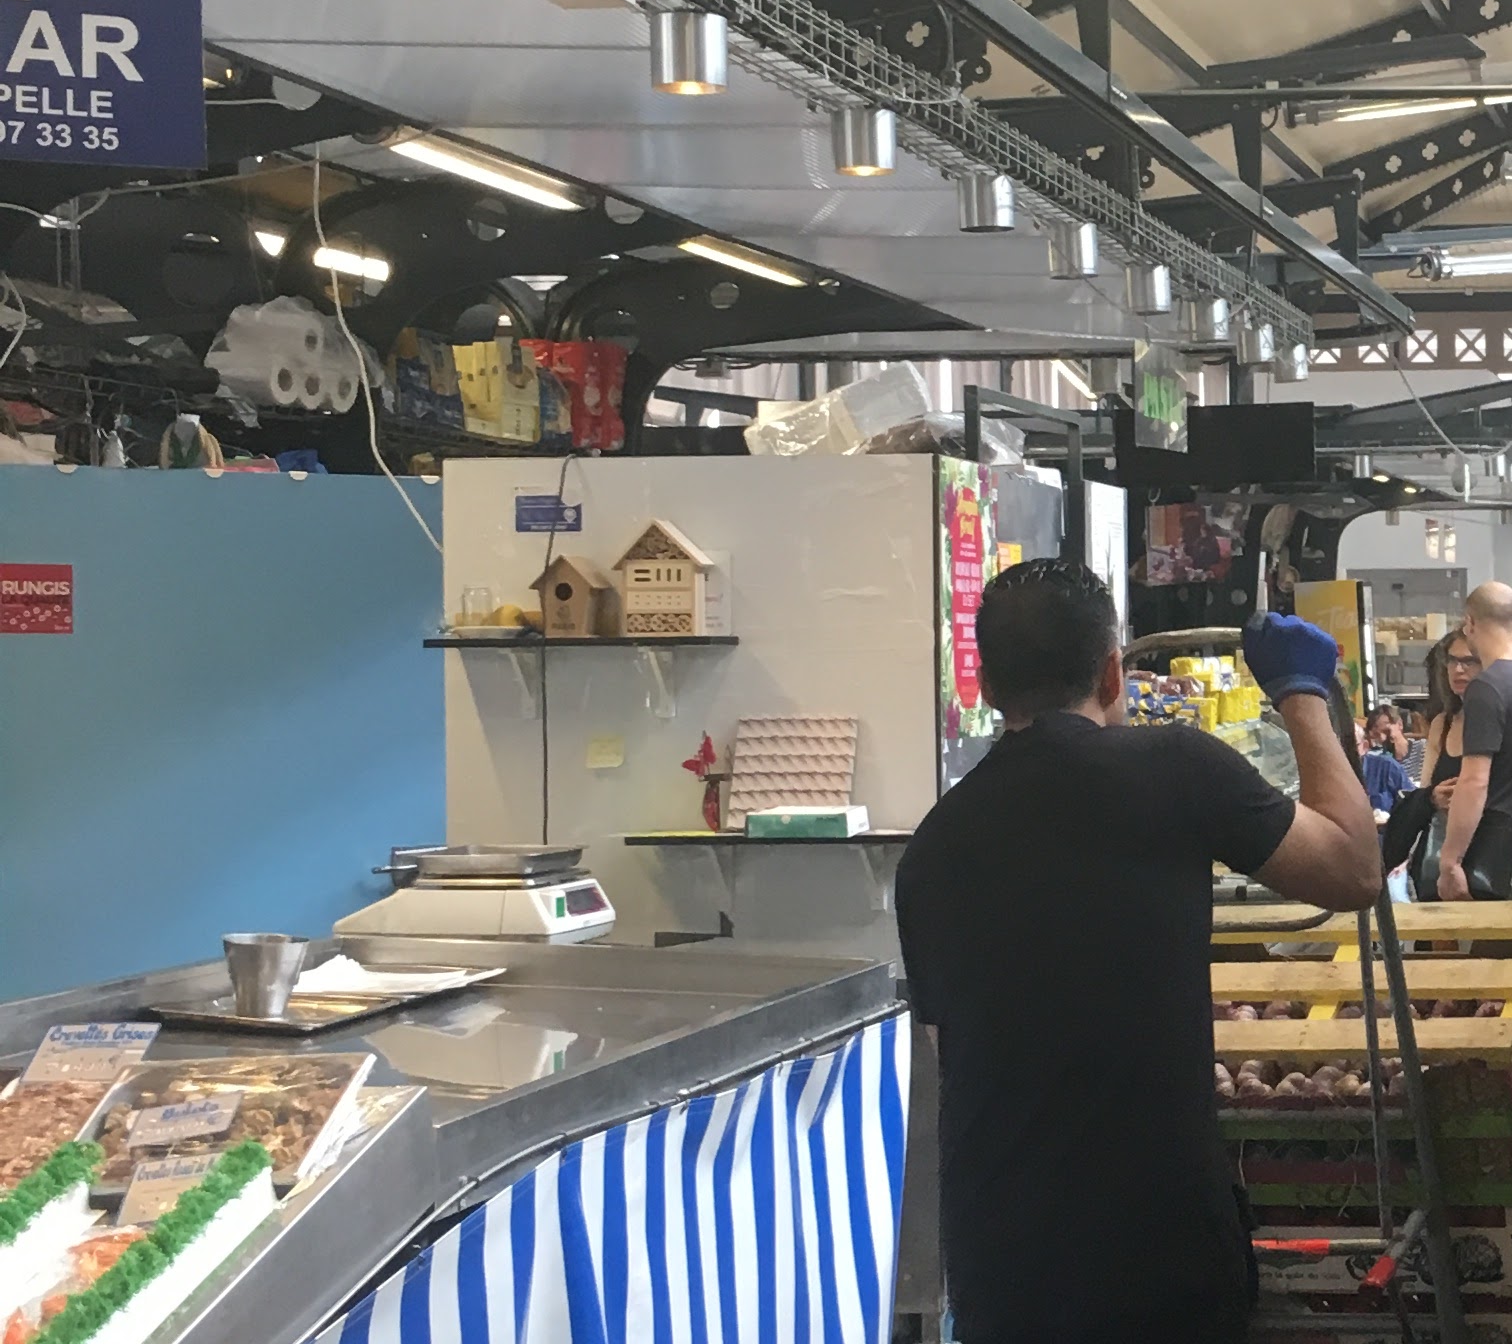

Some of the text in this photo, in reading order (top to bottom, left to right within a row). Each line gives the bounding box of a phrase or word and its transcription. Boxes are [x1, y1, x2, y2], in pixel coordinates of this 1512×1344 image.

[36, 122, 73, 148] 33
[82, 125, 120, 151] 35
[1, 580, 71, 596] RUNGIS
